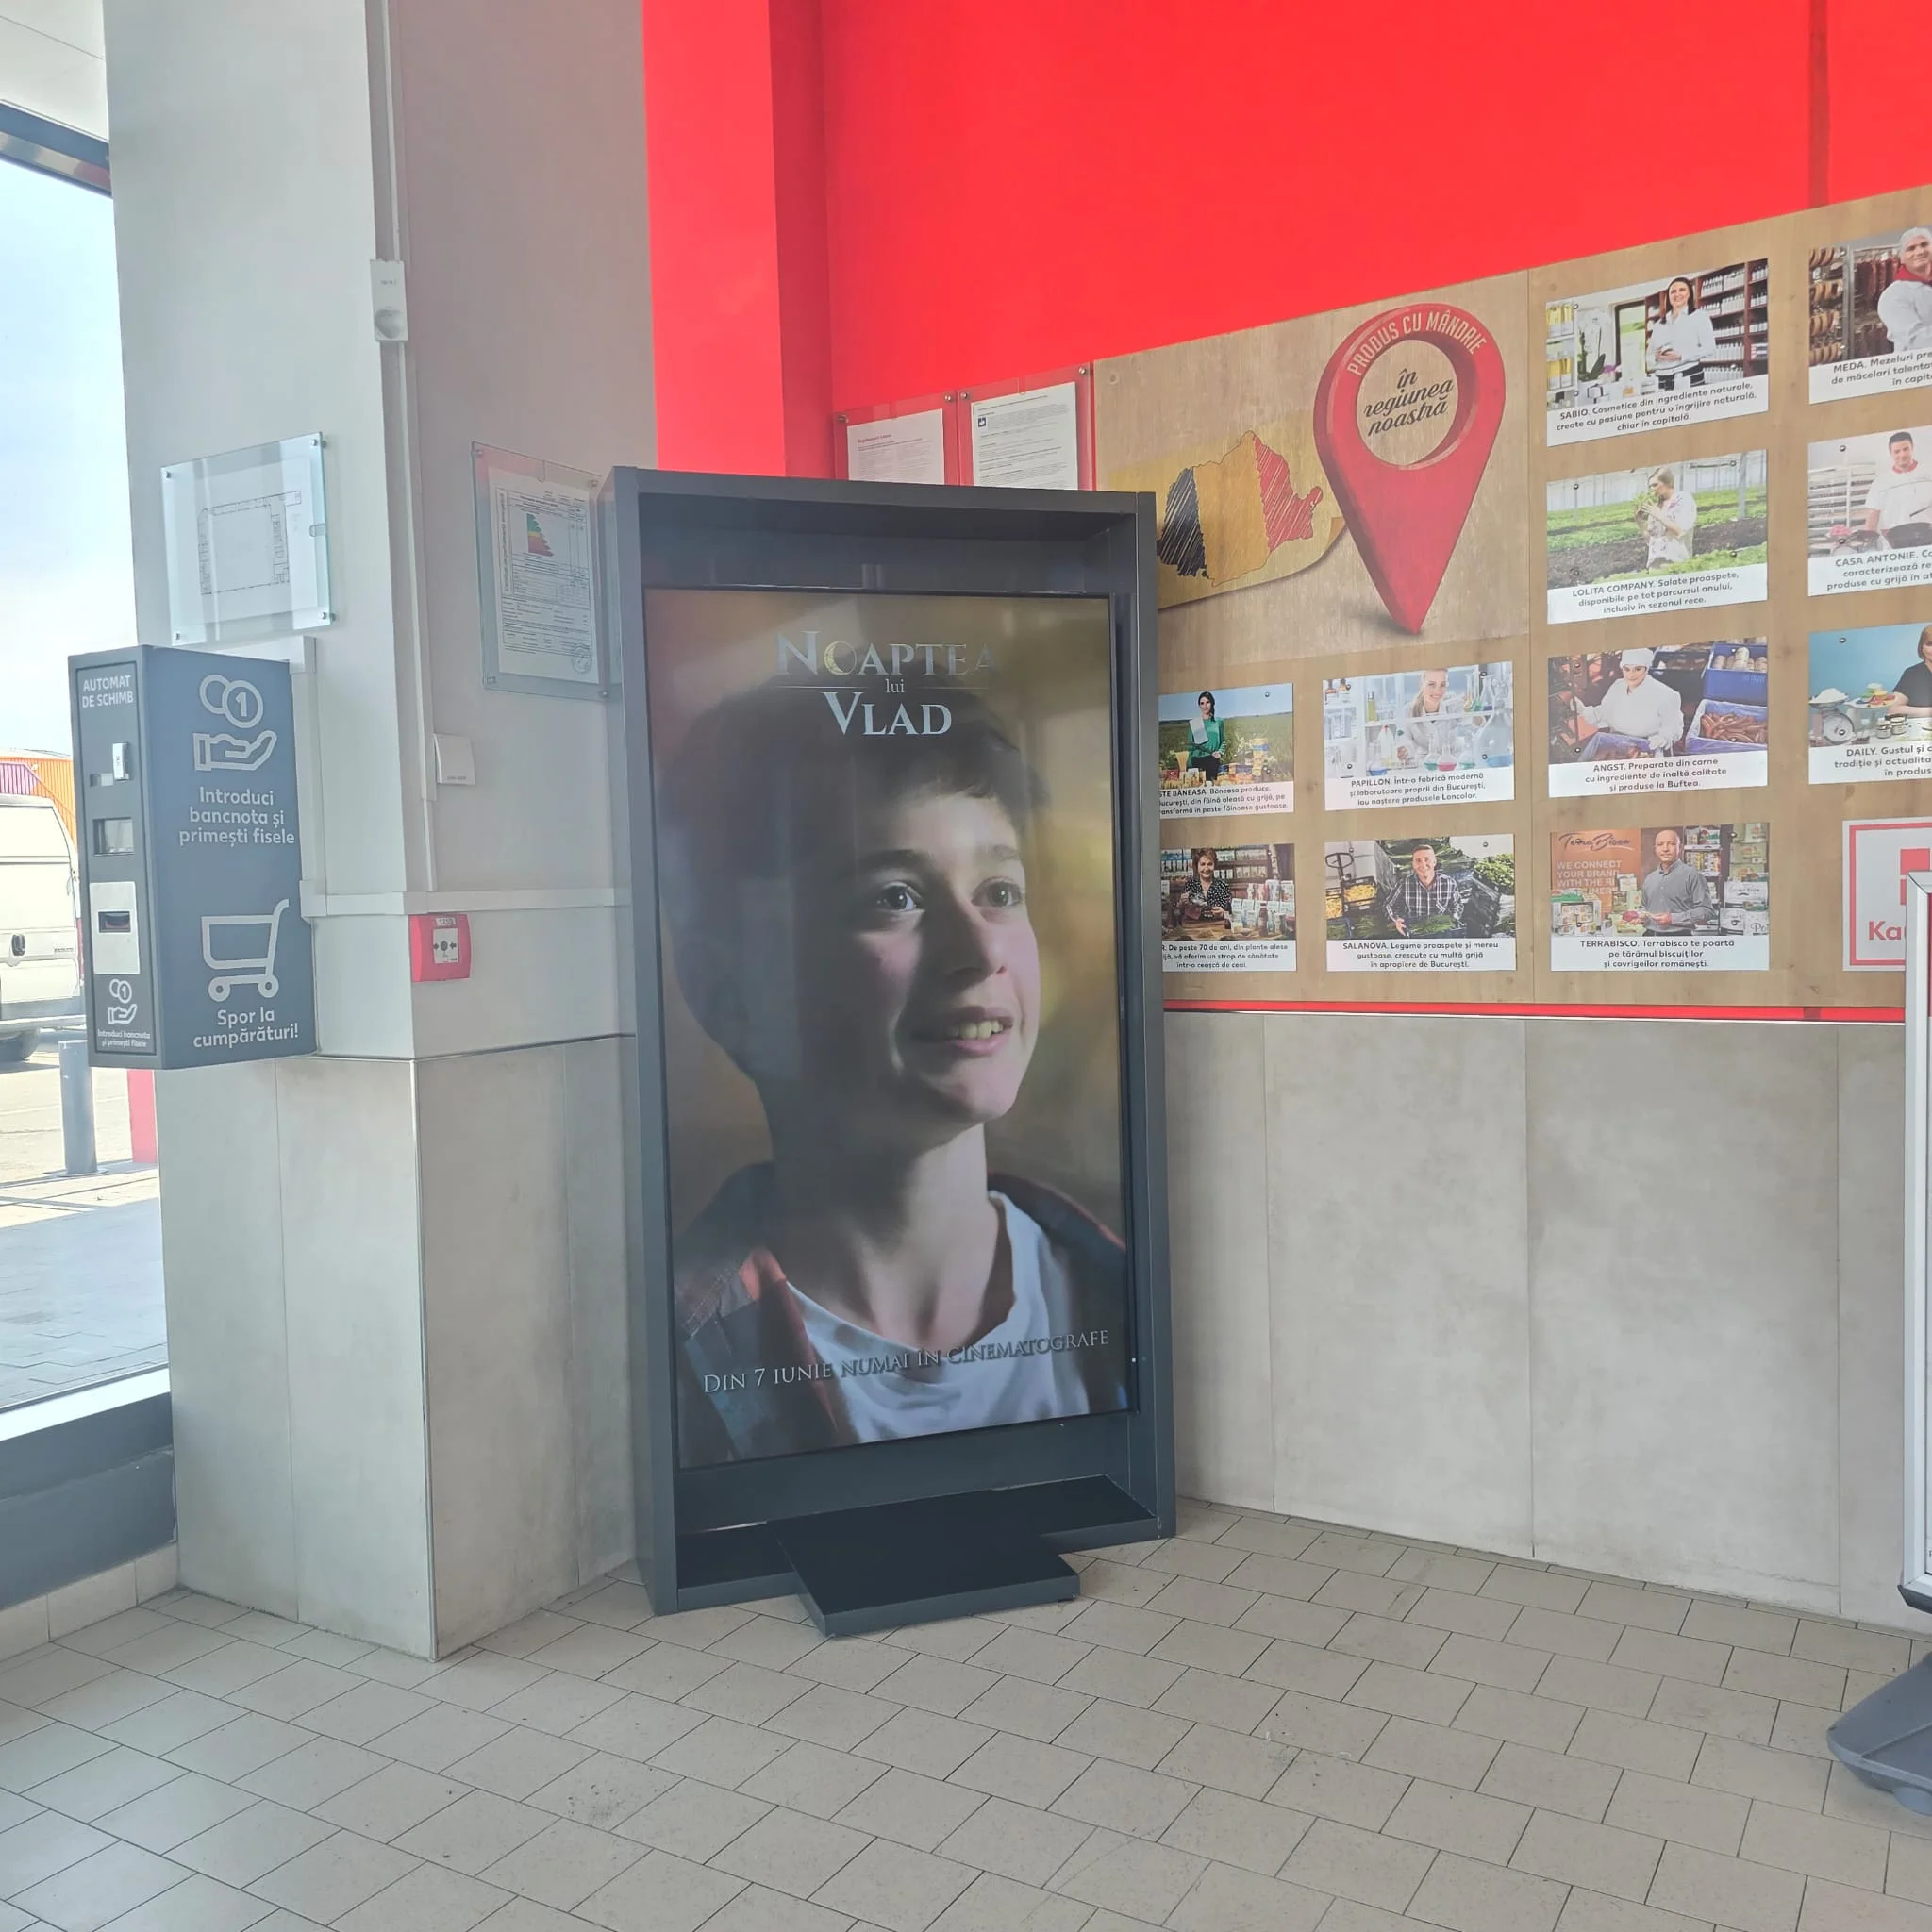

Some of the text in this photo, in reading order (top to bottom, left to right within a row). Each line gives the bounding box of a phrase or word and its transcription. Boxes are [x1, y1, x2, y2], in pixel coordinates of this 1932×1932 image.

[1347, 308, 1488, 377] PRODUS CU MÂNDRIE
[1396, 367, 1418, 390] în
[1363, 378, 1454, 418] regiunea
[1640, 398, 1654, 407] din
[1367, 393, 1449, 437] noastră
[1835, 551, 1919, 568] CASA ANTONIE.
[1572, 586, 1605, 597] LOLITA
[1657, 577, 1688, 587] Salate
[1826, 579, 1867, 591] produse
[1578, 593, 1625, 607] disponibile
[1641, 591, 1655, 599] tot
[1657, 586, 1699, 599] parcursul
[1603, 604, 1636, 614] inclusiv
[776, 630, 996, 676] NOAPTEA
[83, 675, 131, 691] AUTOMAT
[885, 678, 906, 693] lui
[82, 691, 134, 708] DE SCHIMB
[820, 691, 953, 736] VLAD
[1880, 744, 1914, 755] Gustul
[1592, 763, 1626, 773] ANGST.
[1675, 758, 1690, 767] din
[1692, 758, 1719, 766] carne
[199, 786, 274, 806] Introduci
[1618, 782, 1655, 792] produse
[190, 807, 285, 828] bancnota și
[179, 826, 295, 847] primești fisele
[1868, 920, 1907, 941] Ka
[1391, 942, 1420, 951] Legume
[217, 1006, 275, 1029] Spor la
[192, 1022, 299, 1049] cumpărături!
[704, 1373, 745, 1393] DIN
[756, 1367, 766, 1387] 7
[774, 1363, 834, 1384] IUNIE
[841, 1353, 909, 1378] NUMAI
[946, 1329, 1109, 1365] CINEMATOGRAFE
